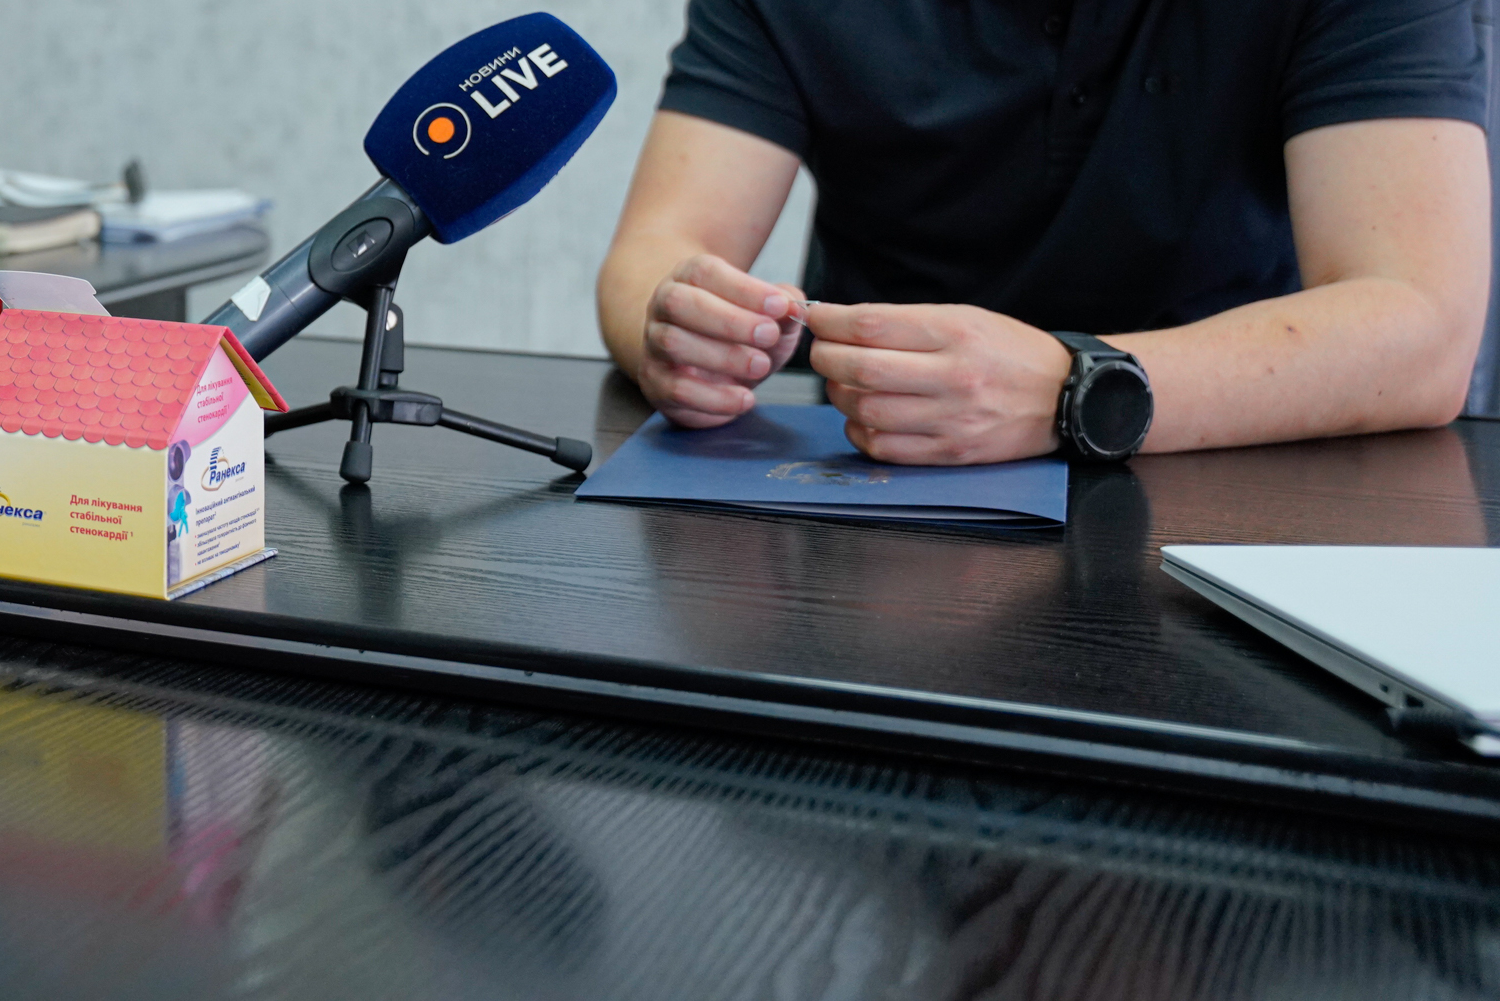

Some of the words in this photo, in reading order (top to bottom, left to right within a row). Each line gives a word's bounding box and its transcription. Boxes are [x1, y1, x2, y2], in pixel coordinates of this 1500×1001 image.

[458, 46, 522, 92] НОВИНИ
[470, 43, 569, 119] LIVE
[210, 461, 246, 485] Ранекса
[70, 495, 89, 506] Для
[91, 498, 142, 512] лікування
[70, 511, 122, 525] стабільної
[70, 526, 128, 541] стенокардії
